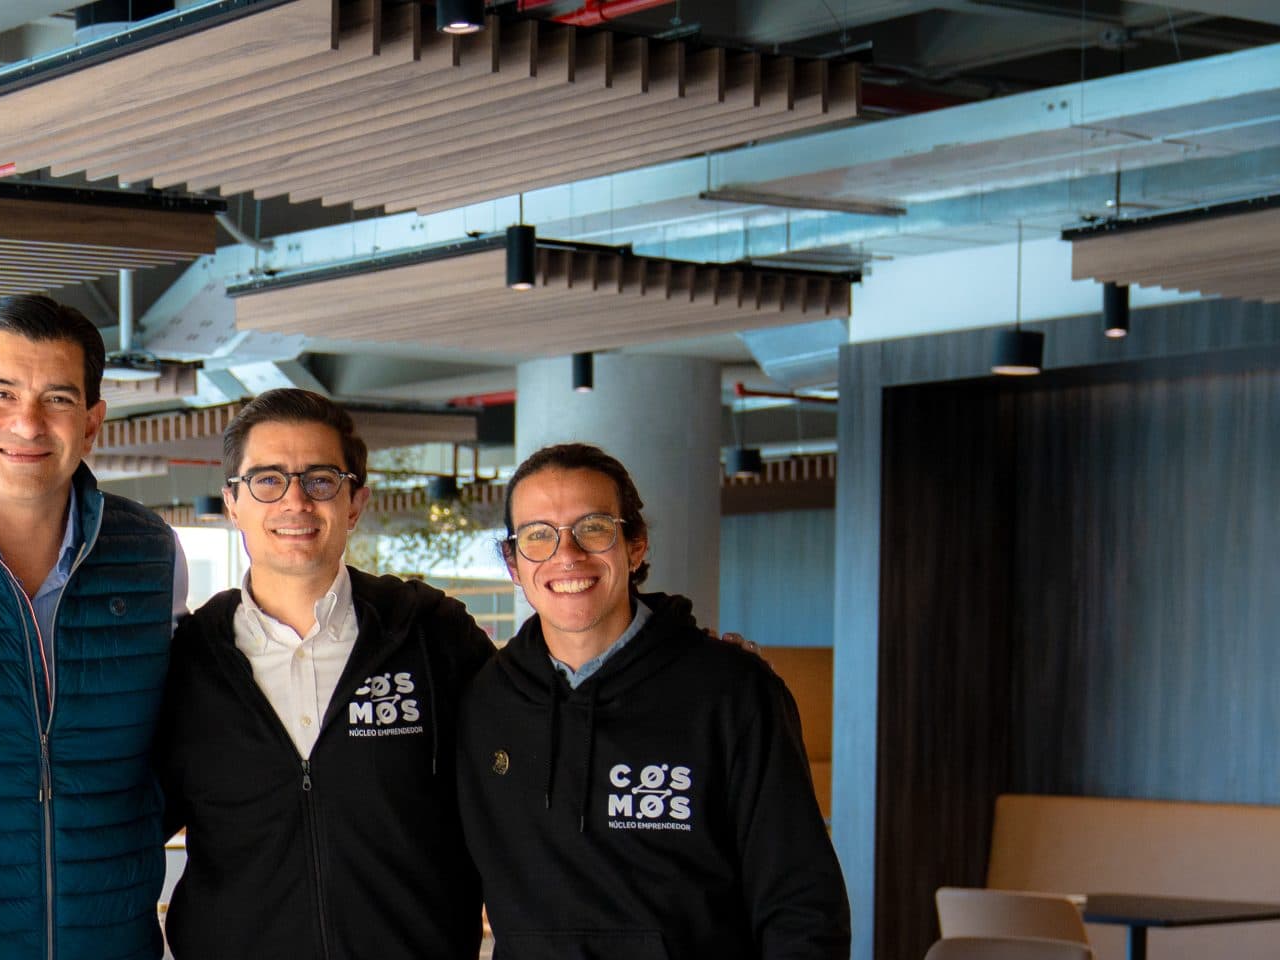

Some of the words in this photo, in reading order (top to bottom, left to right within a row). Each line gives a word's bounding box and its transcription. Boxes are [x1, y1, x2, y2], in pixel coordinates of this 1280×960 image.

[349, 727, 377, 737] NÚCLEO
[377, 726, 423, 737] EMPRENDEDOR
[608, 820, 637, 829] NÚCLEO
[637, 821, 692, 831] EMPRENDEDOR
